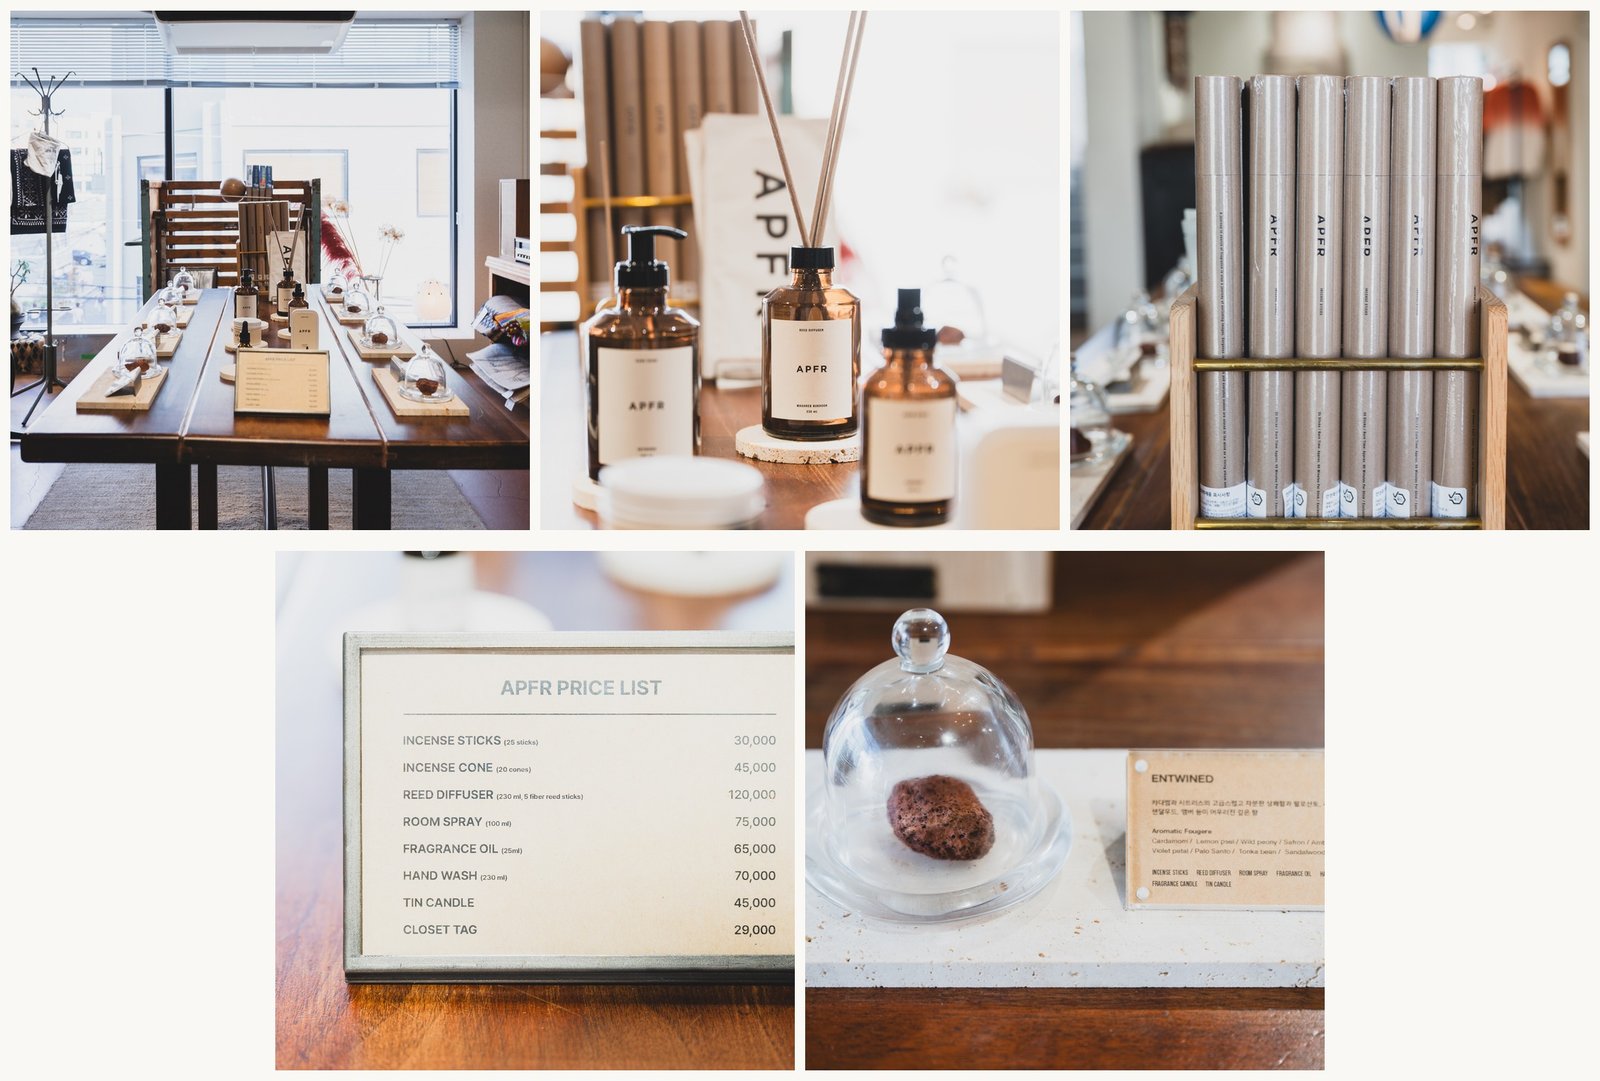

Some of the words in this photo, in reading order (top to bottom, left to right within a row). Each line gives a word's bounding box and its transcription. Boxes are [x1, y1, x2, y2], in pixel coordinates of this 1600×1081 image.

[1317, 214, 1326, 257] APFR
[796, 365, 828, 373] APFR
[629, 401, 664, 411] APFR
[501, 680, 552, 695] APFR
[558, 680, 614, 695] PRICE
[621, 680, 662, 695] LIST
[403, 736, 454, 745] INCENSE
[457, 736, 501, 745] STICKS
[734, 736, 776, 748] 30,000
[403, 763, 455, 772] INCENSE
[459, 763, 493, 772] CONE
[734, 763, 776, 775] 45,000
[1152, 774, 1214, 783] ENTWINED
[403, 790, 433, 799] REED
[437, 790, 493, 799] DIFFUSER
[729, 790, 776, 802] 120,000
[403, 817, 440, 826] ROOM
[443, 817, 482, 826] SPRAY
[735, 817, 776, 829] 75,000
[403, 844, 476, 853] FRAGRANCE
[480, 844, 498, 853] OIL
[734, 844, 776, 856] 65,000
[403, 871, 438, 880] HAND
[441, 871, 477, 880] WASH
[735, 871, 776, 883] 70,000
[403, 898, 422, 907] TIN
[426, 898, 474, 907] CANDLE
[734, 898, 776, 910] 45,000
[403, 925, 450, 934] CLOSET
[453, 925, 477, 934] TAG
[734, 925, 776, 937] 29,000
